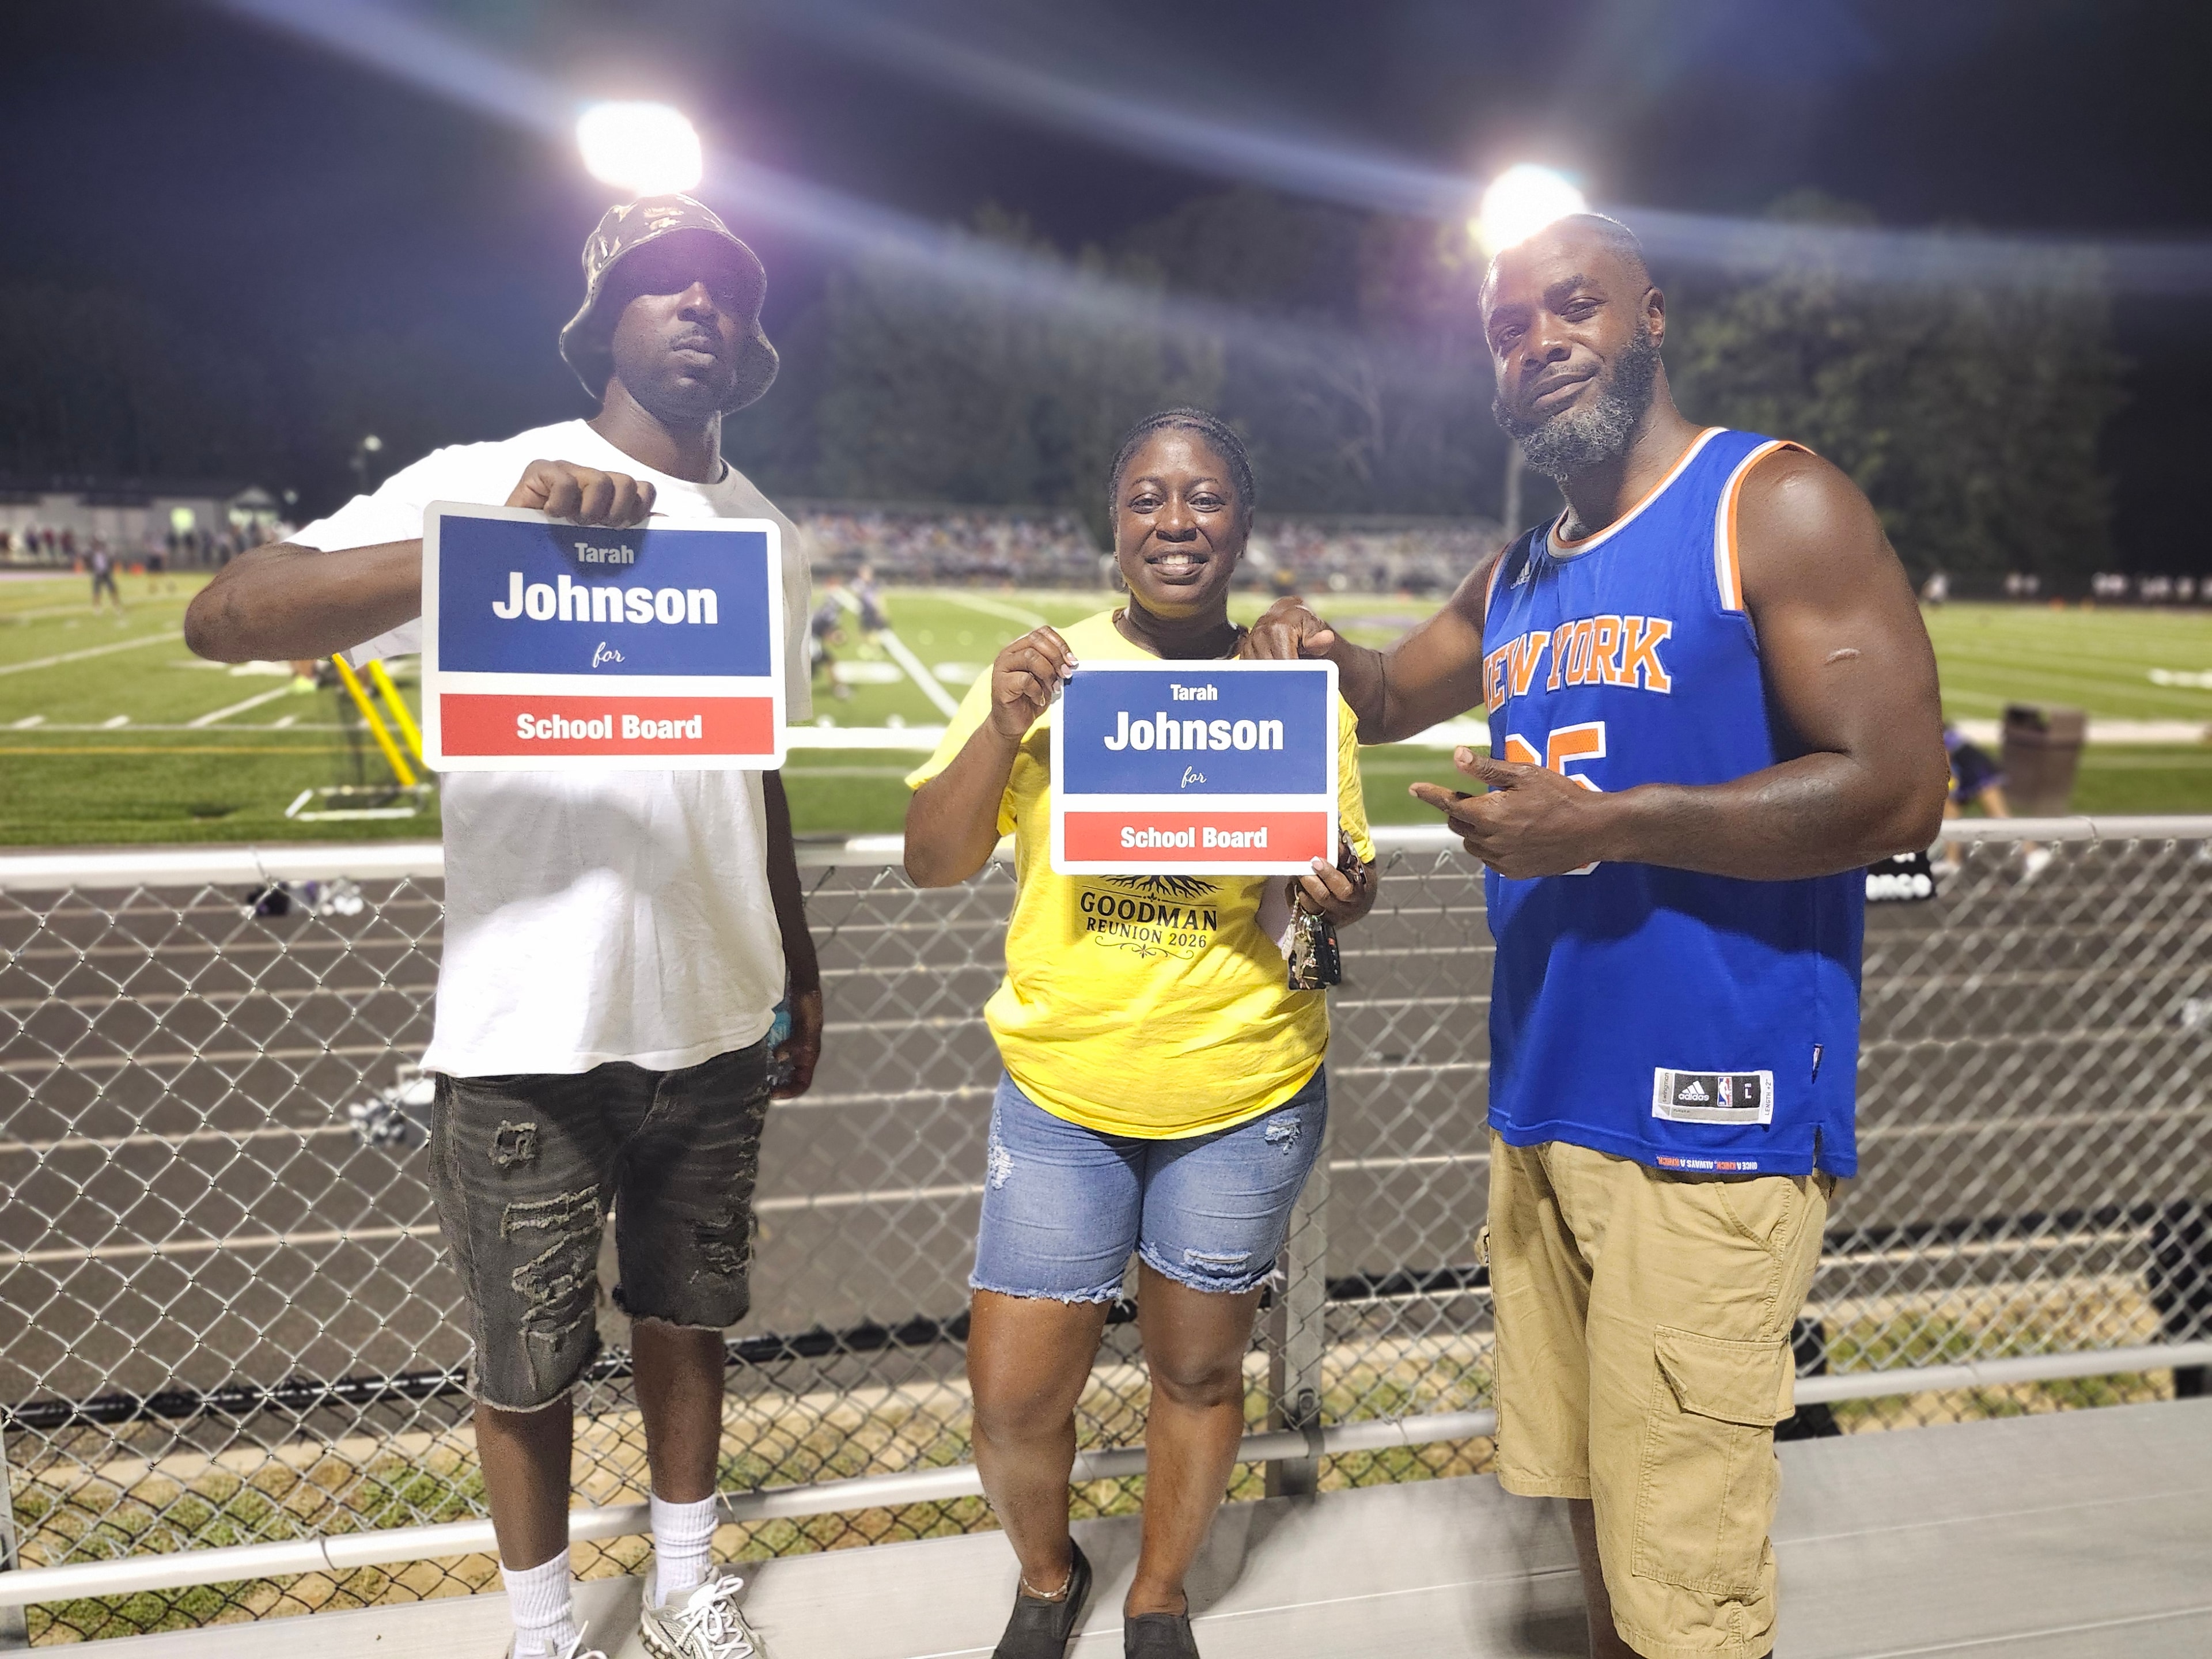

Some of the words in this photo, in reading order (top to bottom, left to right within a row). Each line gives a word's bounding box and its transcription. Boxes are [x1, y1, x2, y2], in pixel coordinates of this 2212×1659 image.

[574, 542, 634, 565] Tarah
[492, 571, 718, 624] Johnson
[591, 641, 625, 668] for
[1546, 615, 1673, 694] YORK
[1170, 684, 1218, 701] Tarah
[516, 713, 613, 740] School
[622, 714, 702, 740] Board
[1103, 711, 1284, 751] Johnson
[1180, 766, 1207, 789] for
[1120, 826, 1195, 849] School
[1202, 827, 1268, 849] Board
[1080, 891, 1217, 931] GOODMAN
[1086, 916, 1162, 944] REUNION
[1168, 933, 1207, 948] 2026
[1678, 1093, 1710, 1101] adidas
[1680, 1159, 1685, 1167] A
[1686, 1160, 1714, 1169] ALWAYS
[1737, 1162, 1741, 1171] A
[1743, 1162, 1758, 1170] ONCE
